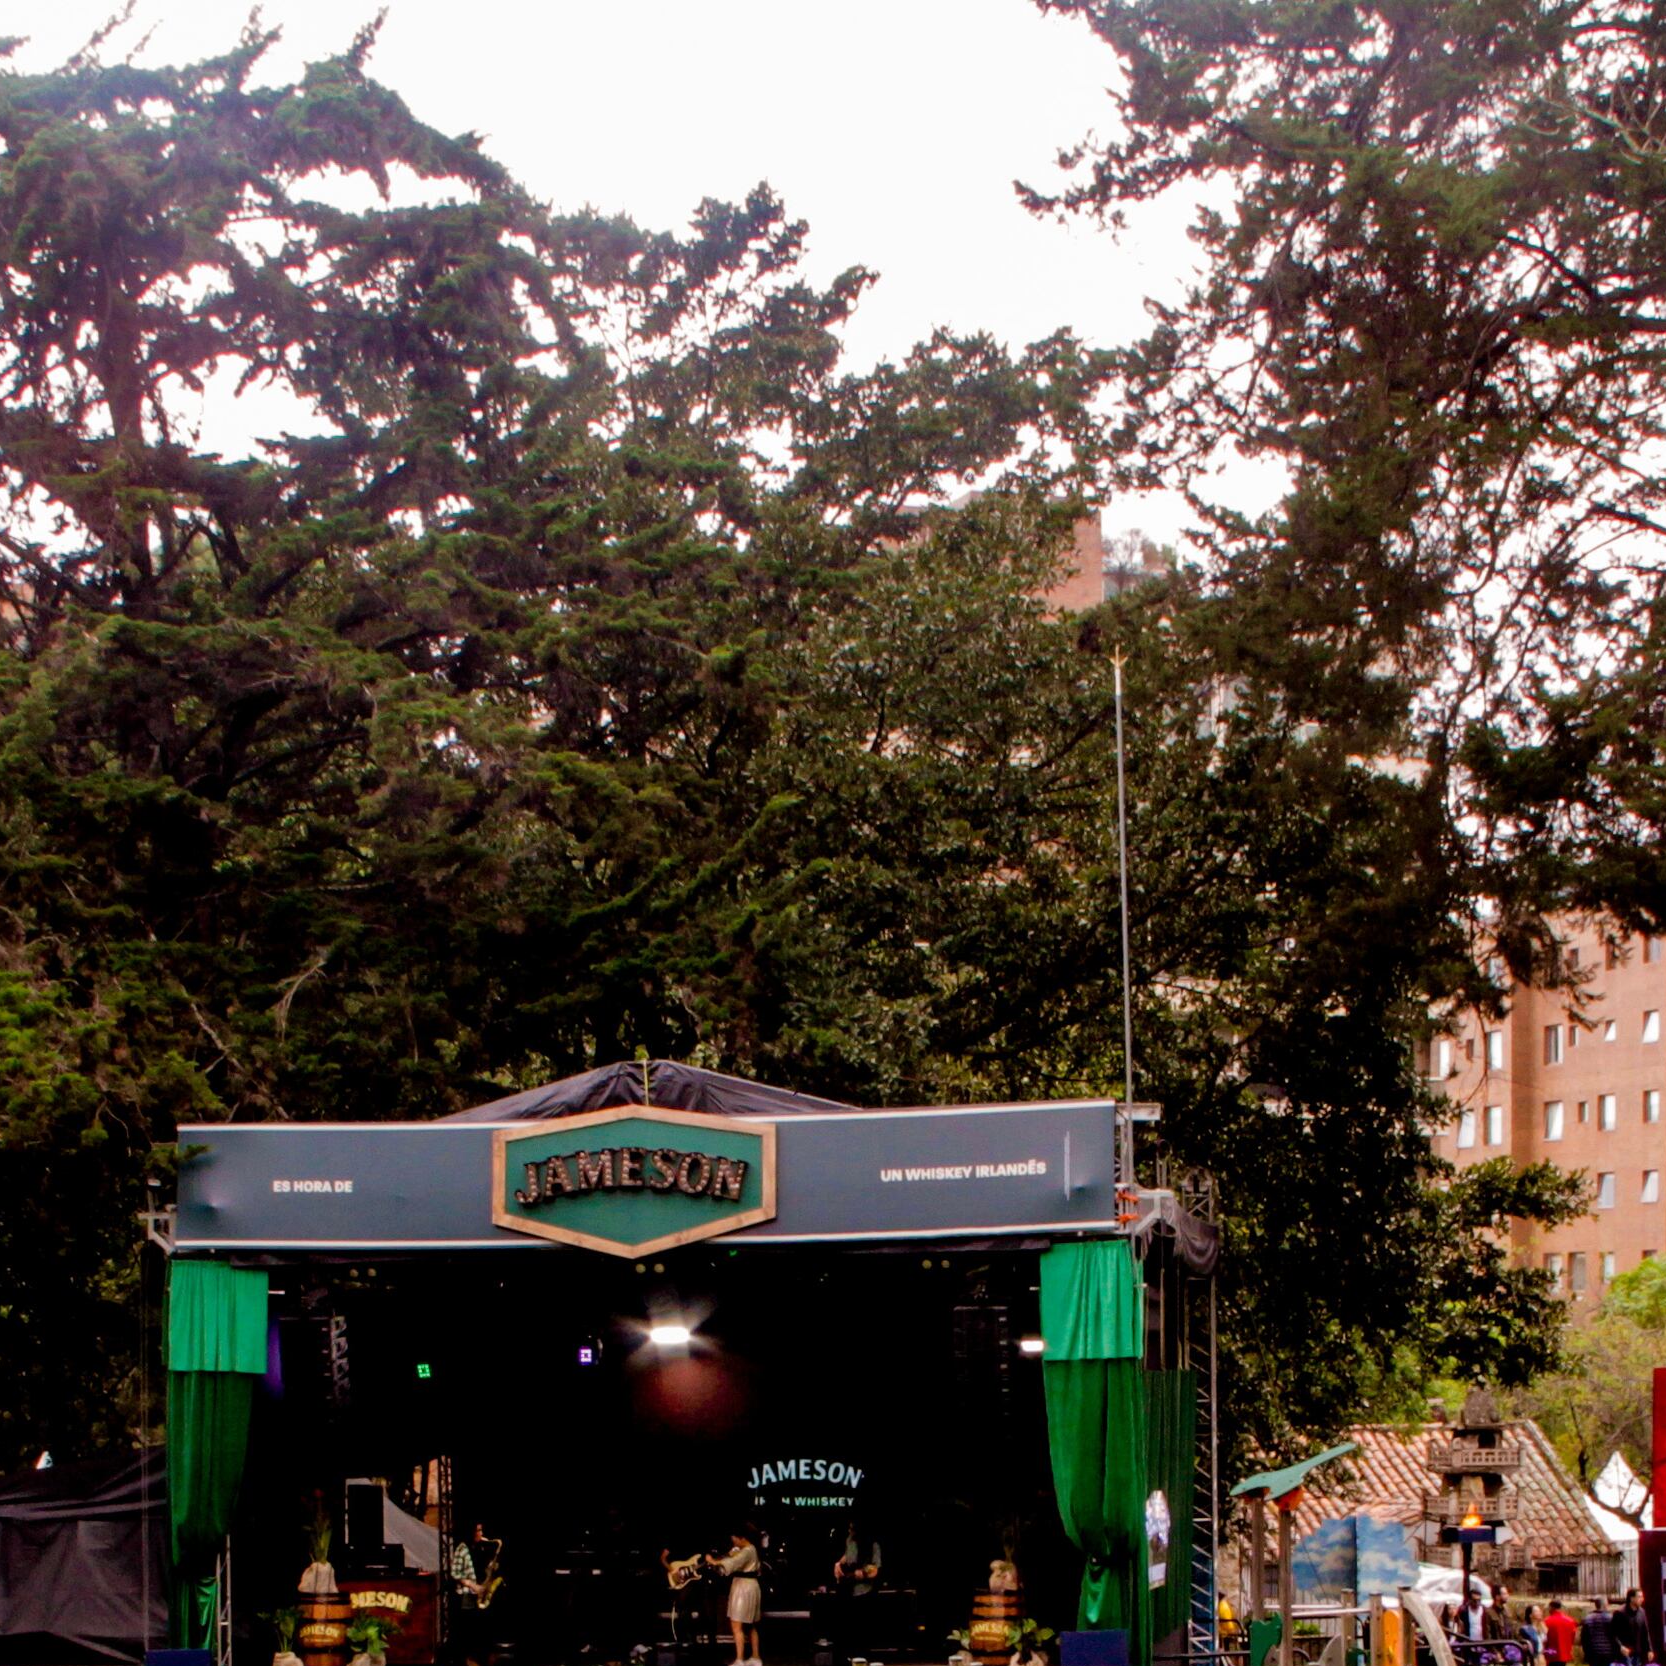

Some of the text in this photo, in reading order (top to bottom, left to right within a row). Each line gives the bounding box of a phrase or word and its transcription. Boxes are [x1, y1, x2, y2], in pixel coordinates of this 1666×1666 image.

[514, 1147, 748, 1206] JAMESON
[881, 1169, 902, 1182] UN
[905, 1166, 972, 1181] WHISKEY
[273, 1180, 353, 1193] ES HORA DE
[747, 1459, 862, 1489] JAMESON
[794, 1496, 855, 1507] WHISKEY
